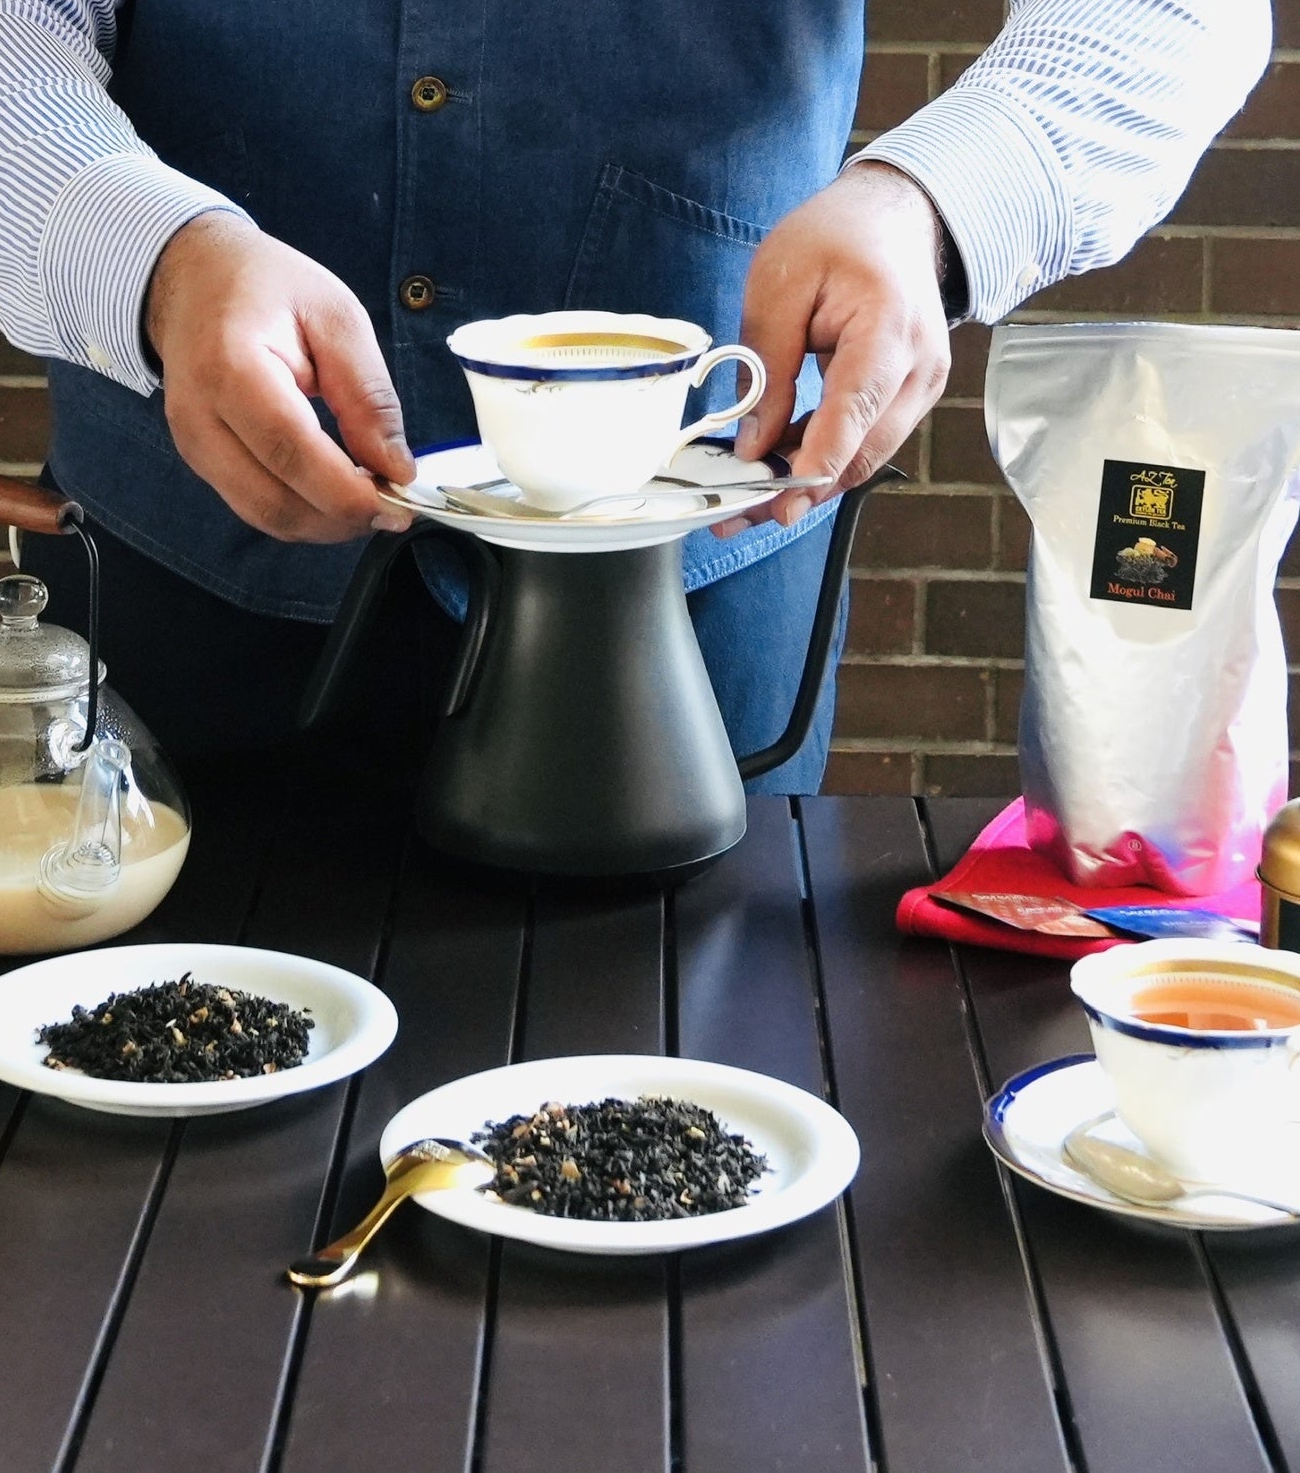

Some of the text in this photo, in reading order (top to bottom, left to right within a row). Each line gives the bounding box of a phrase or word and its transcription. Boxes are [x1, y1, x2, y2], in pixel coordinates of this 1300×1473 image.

[1113, 514, 1147, 527] Premium
[1149, 518, 1170, 530] Black
[1172, 521, 1186, 531] Tea
[1107, 582, 1176, 601] Mogul Chai
